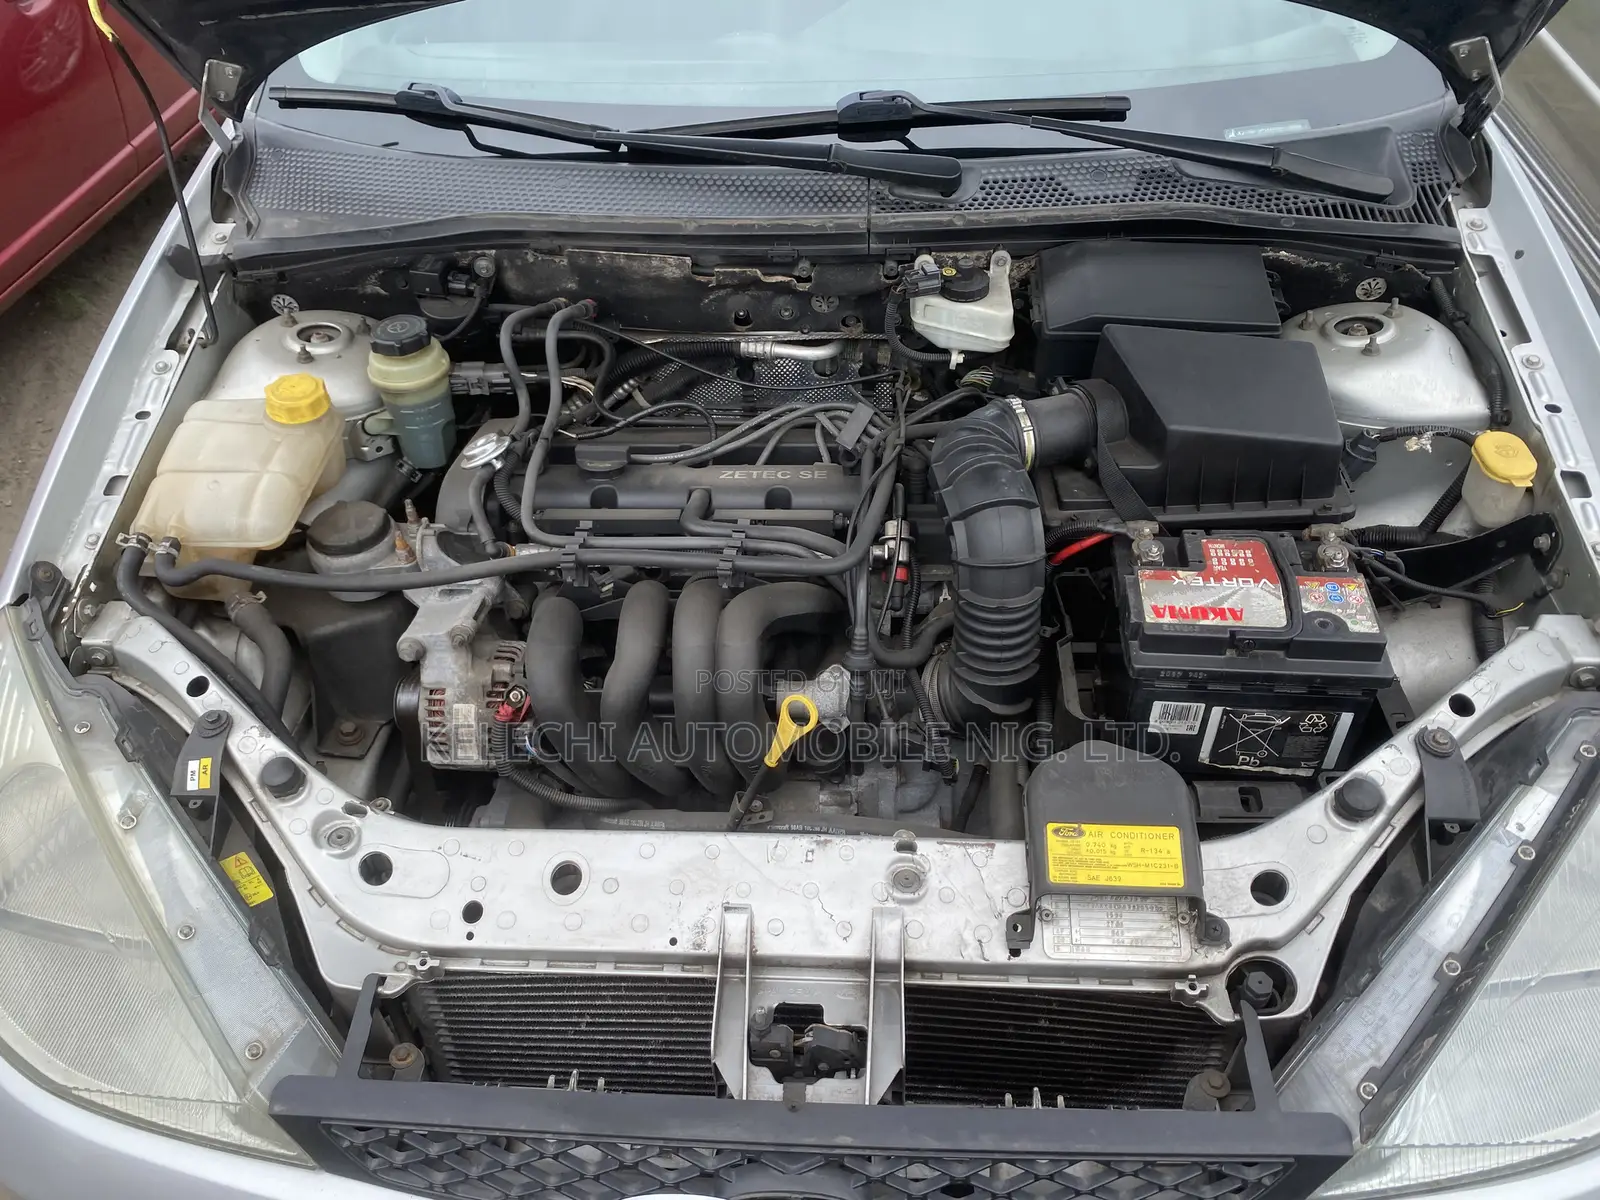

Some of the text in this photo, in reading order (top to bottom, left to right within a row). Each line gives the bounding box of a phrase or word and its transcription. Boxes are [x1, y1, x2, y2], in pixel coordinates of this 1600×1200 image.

[720, 470, 828, 479] ZETEC SE
[1171, 575, 1276, 589] VORTEX
[1150, 604, 1244, 622] AKUMA
[1237, 755, 1260, 766] Pb
[202, 764, 208, 775] AR
[190, 769, 197, 782] PM
[1088, 831, 1104, 839] AIR
[1110, 831, 1175, 840] CONDITIONER
[1087, 874, 1100, 882] SAE
